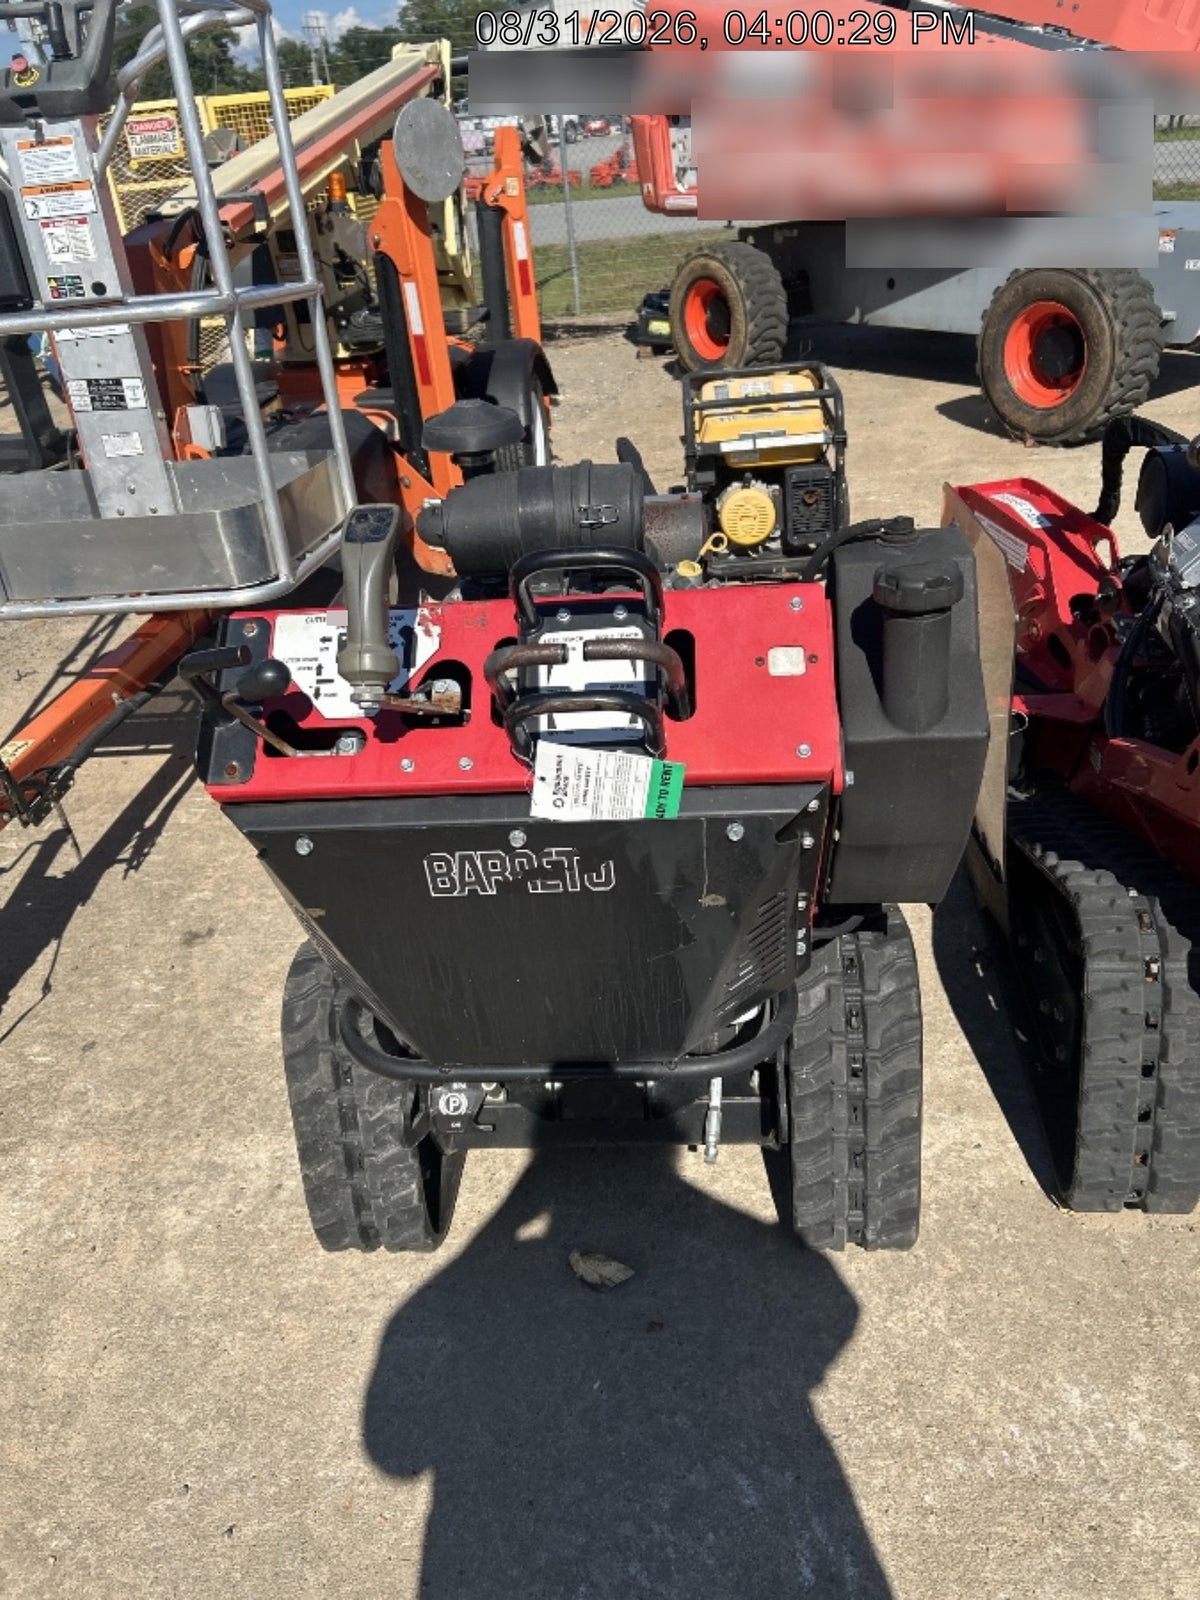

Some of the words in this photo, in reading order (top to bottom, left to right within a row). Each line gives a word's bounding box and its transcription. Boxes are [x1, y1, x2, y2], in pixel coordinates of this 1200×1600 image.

[131, 119, 170, 132] DANGER
[130, 130, 177, 146] FLAMMABLE
[134, 143, 178, 155] MATERIALS
[661, 763, 673, 786] RENT
[659, 788, 668, 800] TO
